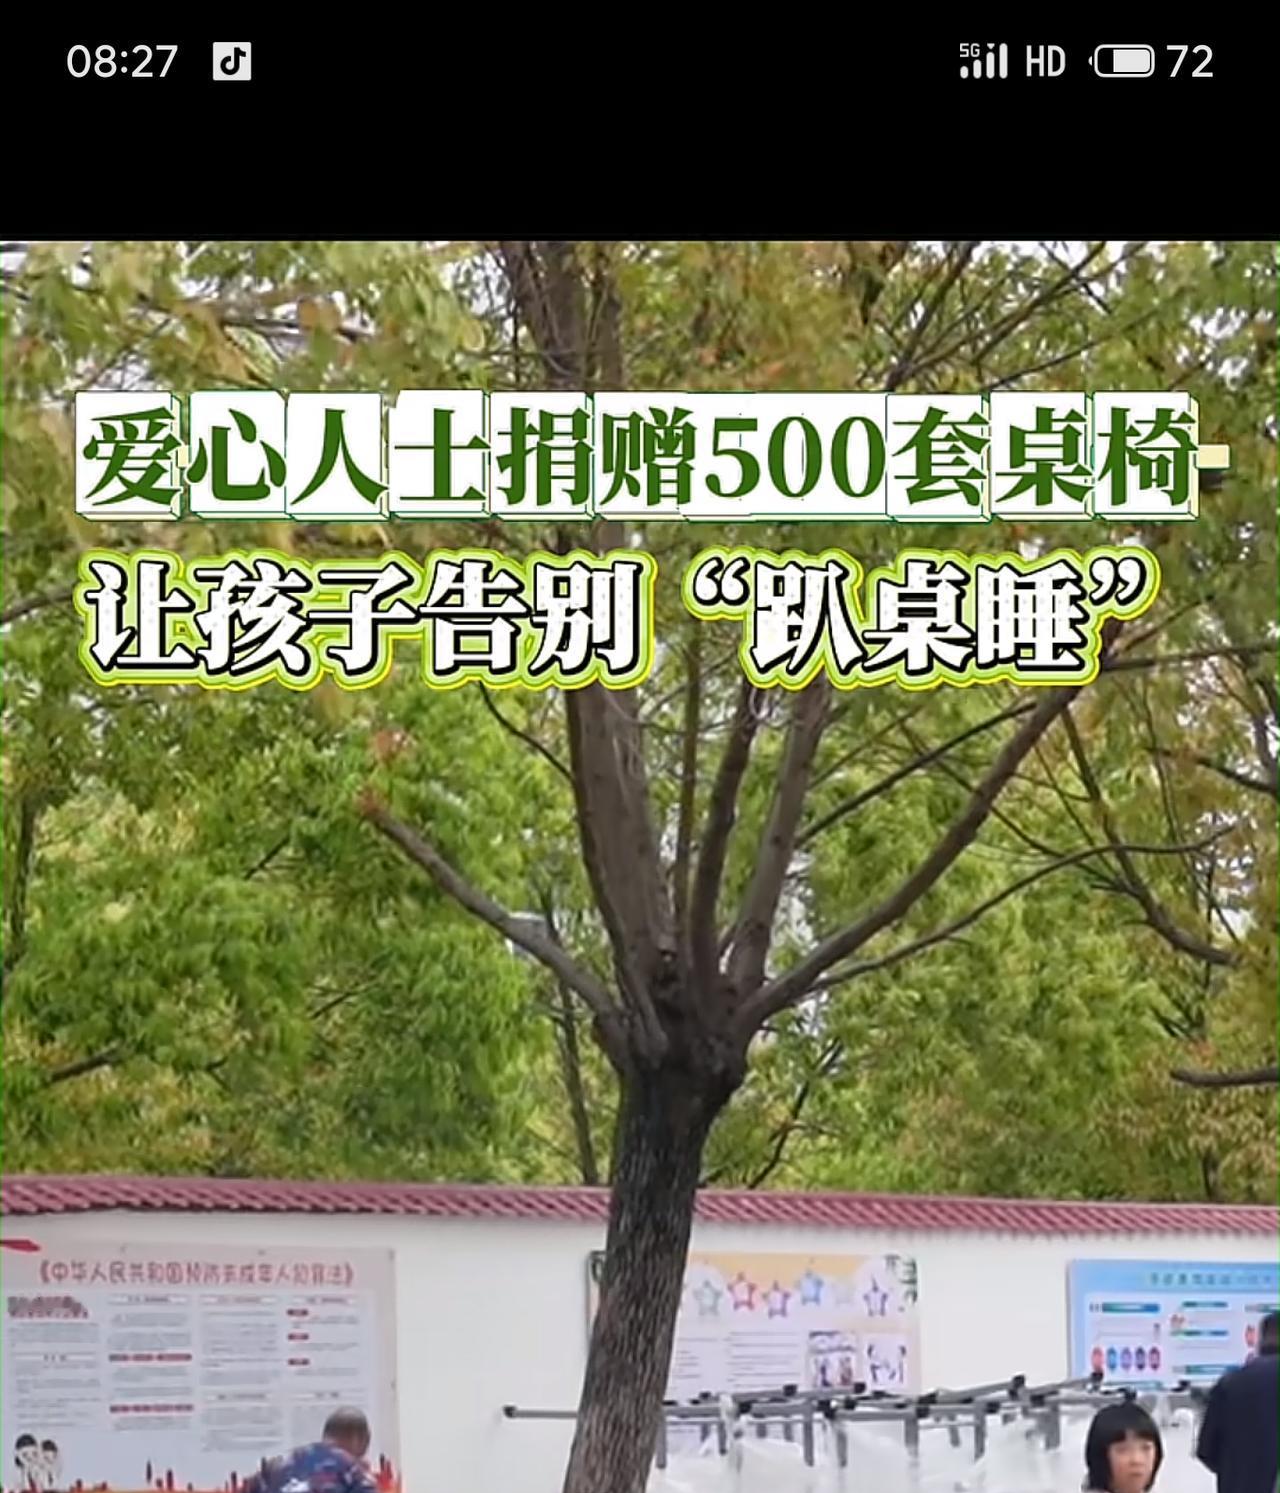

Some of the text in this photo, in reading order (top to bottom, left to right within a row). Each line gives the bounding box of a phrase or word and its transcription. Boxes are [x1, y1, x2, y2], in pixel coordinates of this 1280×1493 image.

[66, 44, 178, 78] 08:27
[959, 42, 981, 58] 5G
[1026, 44, 1066, 77] HD
[1166, 44, 1214, 78] 72
